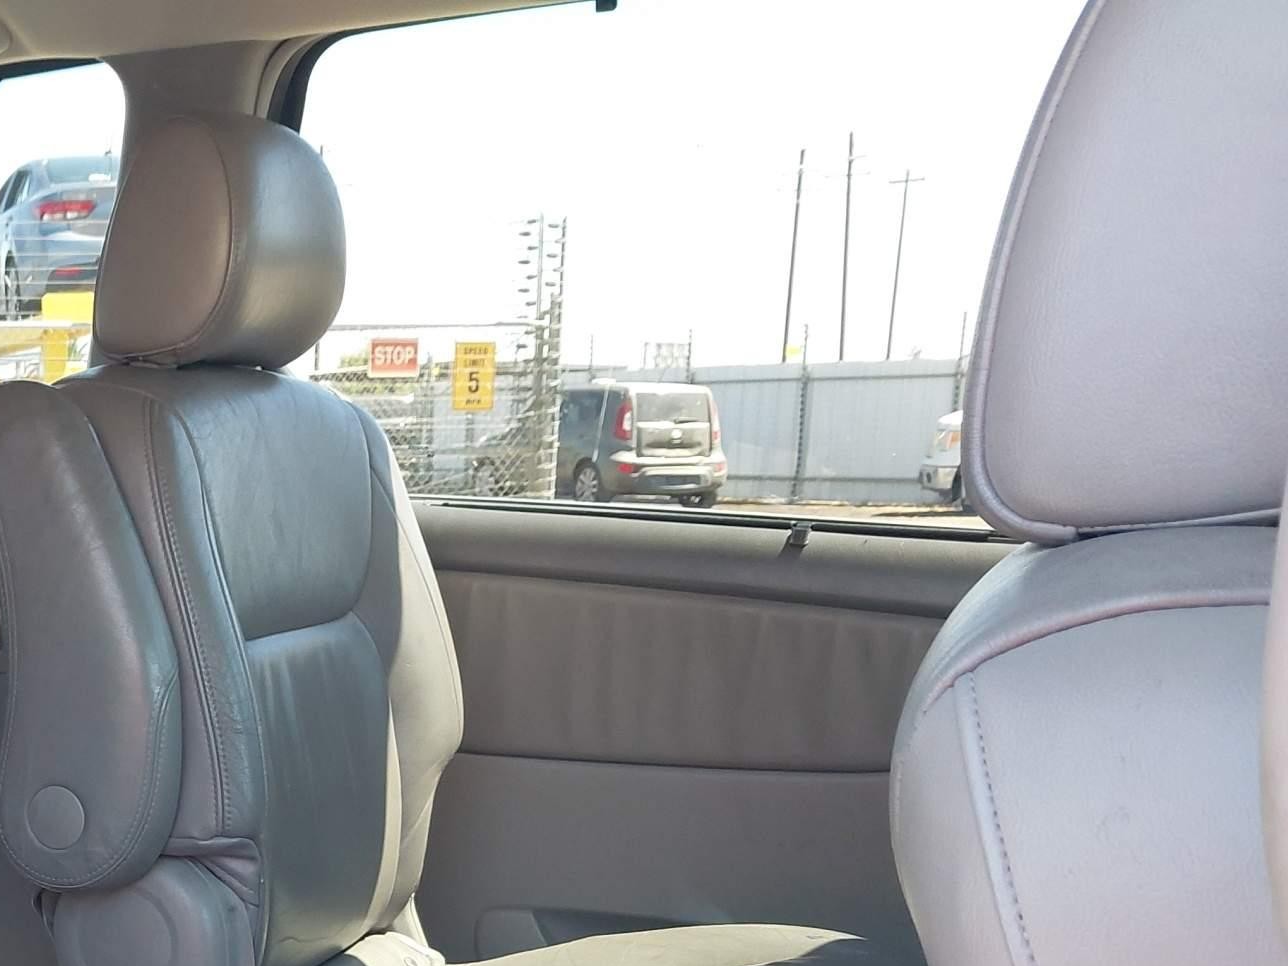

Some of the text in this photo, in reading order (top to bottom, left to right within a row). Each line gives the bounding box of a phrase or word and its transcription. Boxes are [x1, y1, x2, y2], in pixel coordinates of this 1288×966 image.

[374, 345, 415, 366] STOP
[463, 346, 489, 355] SPEED
[468, 371, 480, 393] 5
